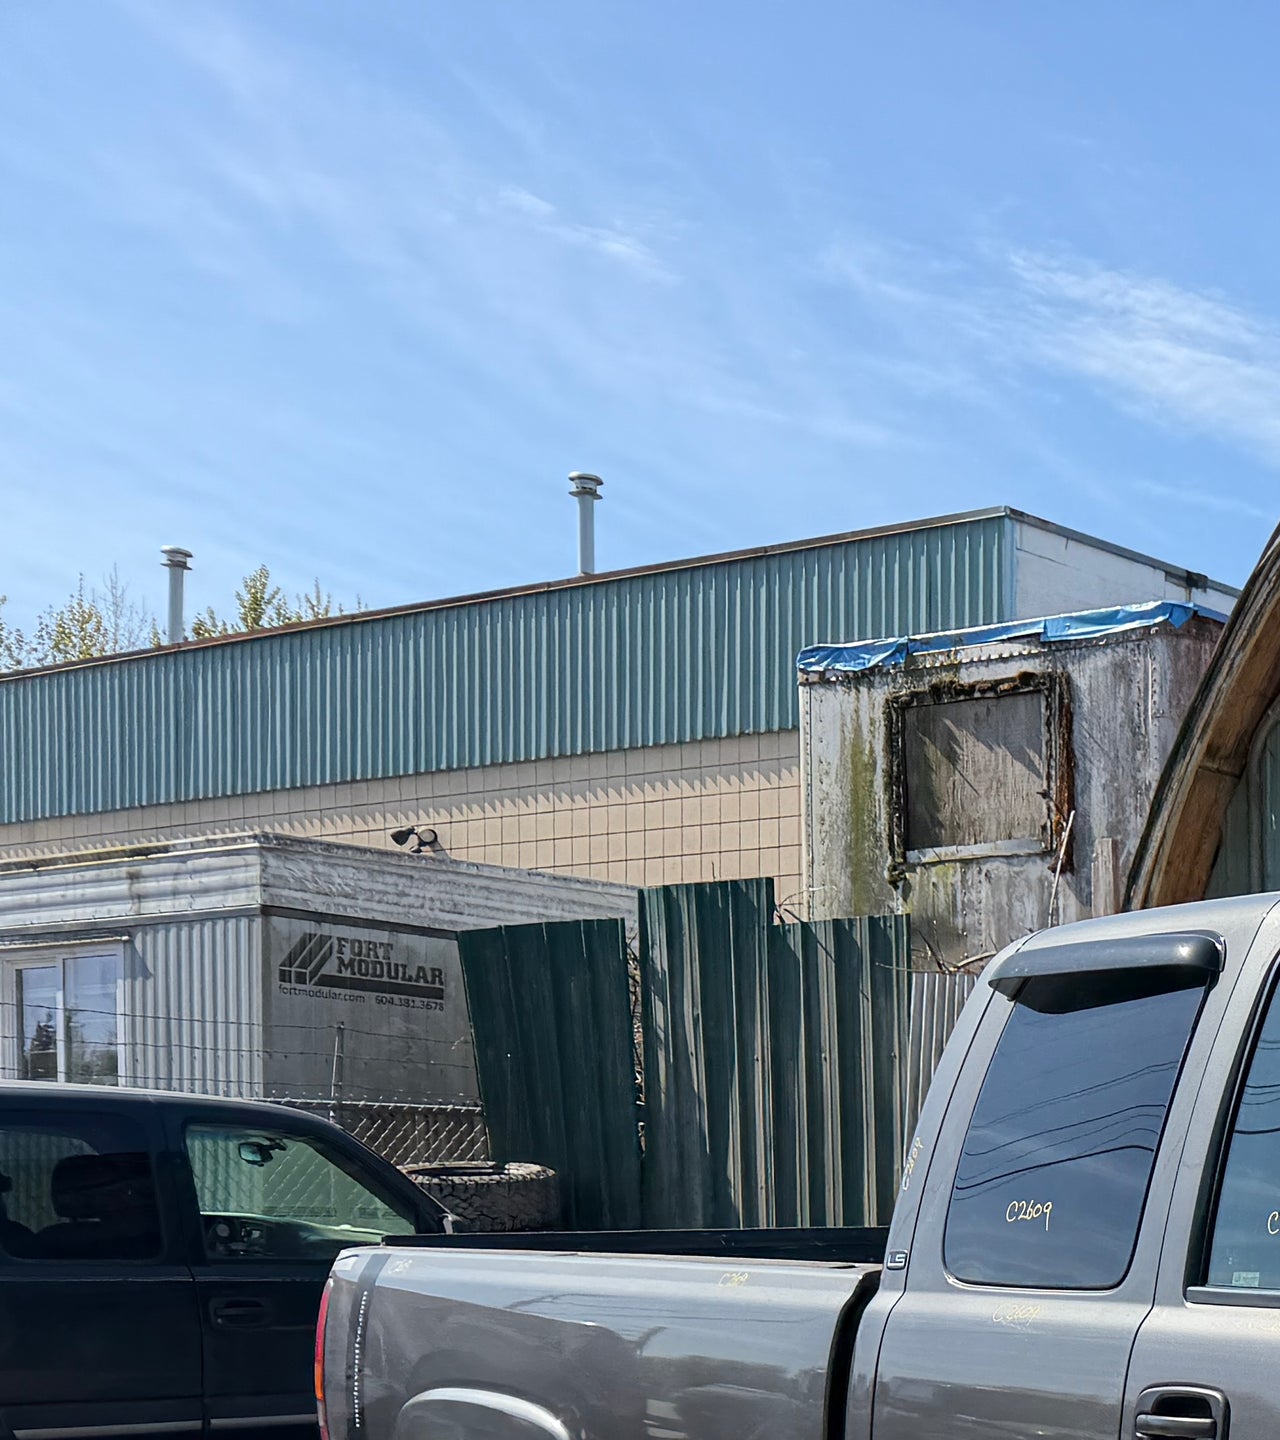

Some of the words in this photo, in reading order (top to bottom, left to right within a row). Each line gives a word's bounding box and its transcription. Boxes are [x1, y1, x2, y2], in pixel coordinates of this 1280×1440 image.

[335, 936, 393, 961] FORT
[335, 955, 444, 986] MODULAR
[278, 983, 366, 1004] fortmodular.com
[1006, 1199, 1053, 1231] C2609
